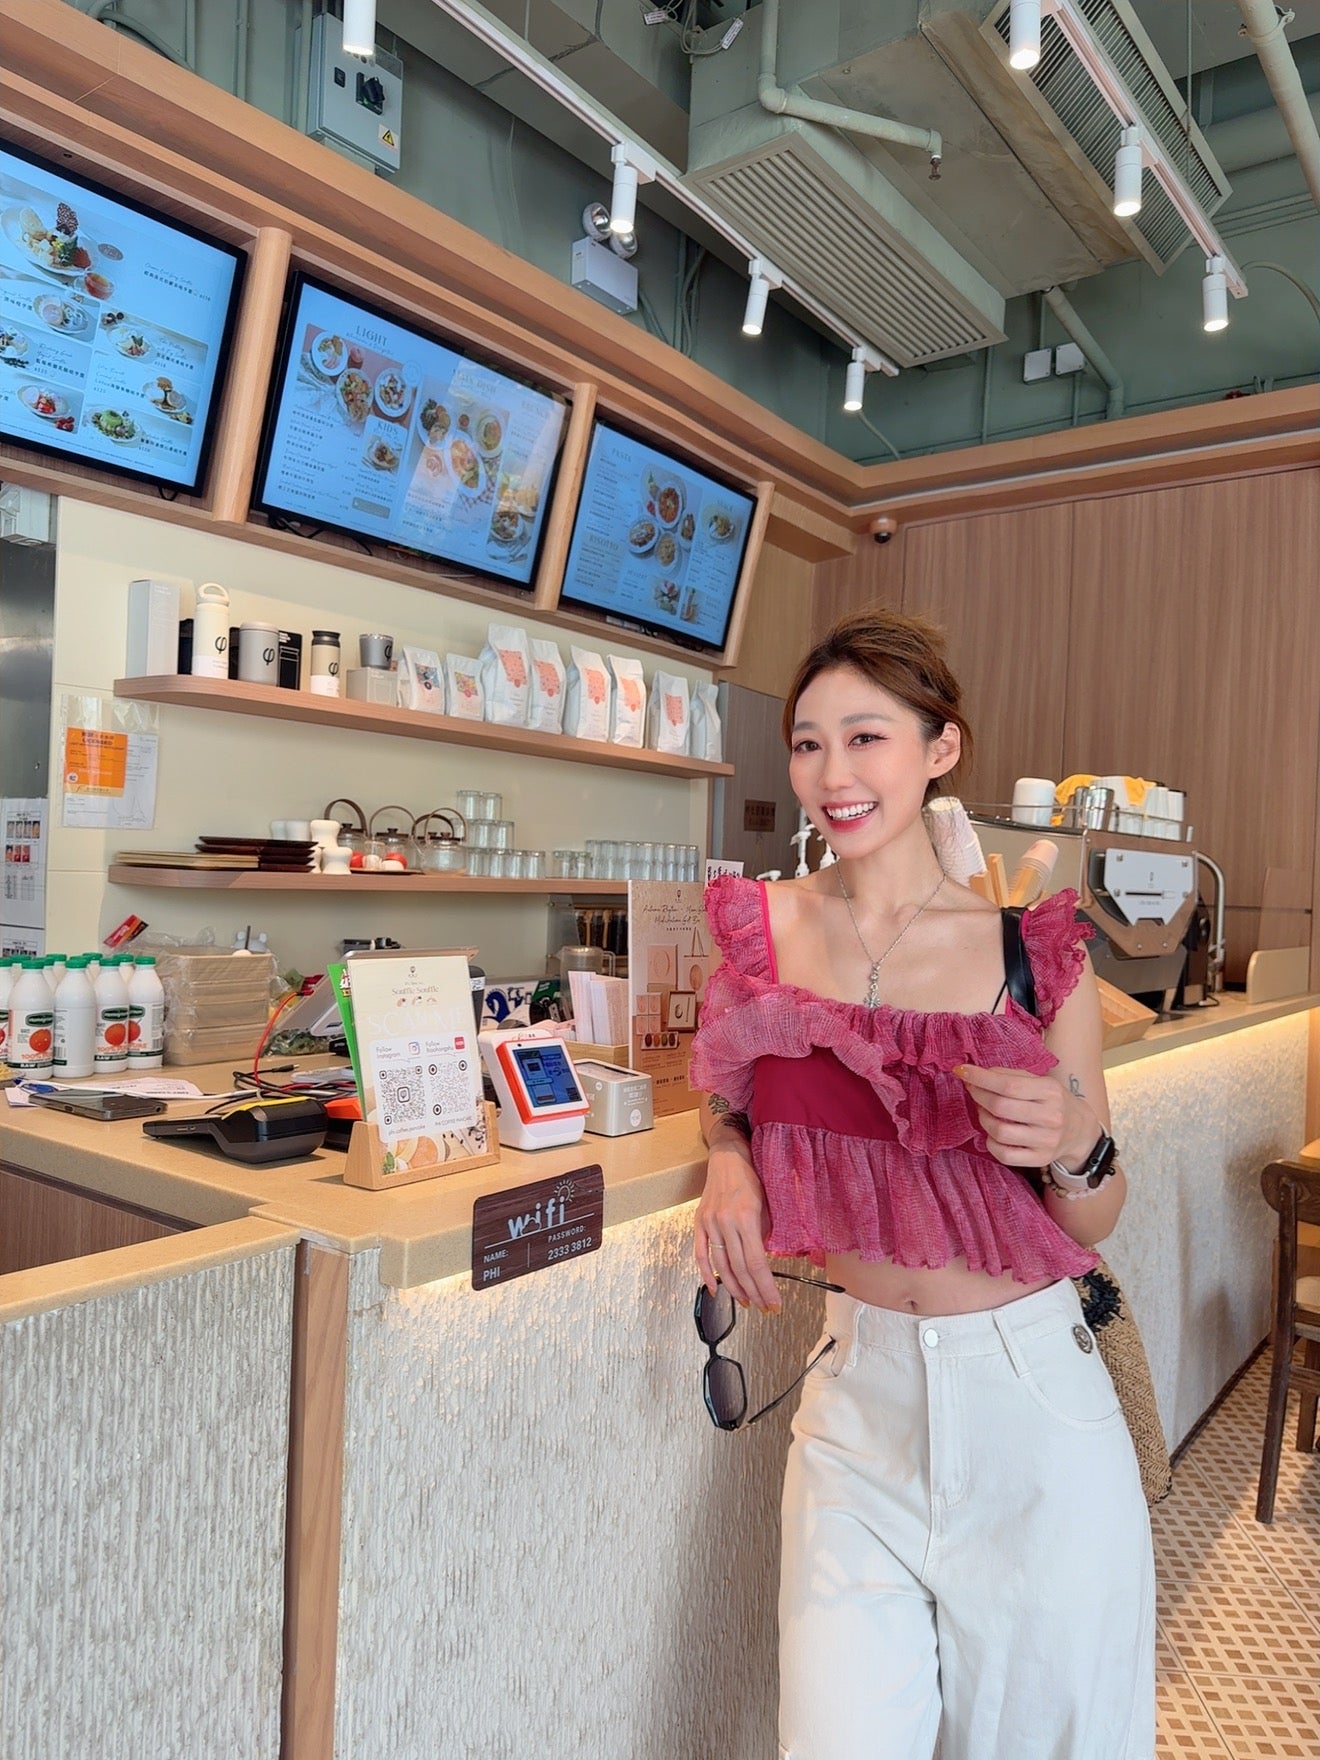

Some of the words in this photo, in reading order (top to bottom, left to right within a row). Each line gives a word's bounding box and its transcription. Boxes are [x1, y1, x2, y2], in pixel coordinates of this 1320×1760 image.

[356, 324, 388, 346] LIGHT
[377, 422, 398, 435] KIDS
[508, 1196, 564, 1240] wifi
[548, 1225, 586, 1243] PASSWORD:
[483, 1249, 509, 1264] NAME:
[548, 1244, 570, 1260] 2333
[570, 1237, 592, 1252] 3812
[482, 1266, 500, 1282] PHI
